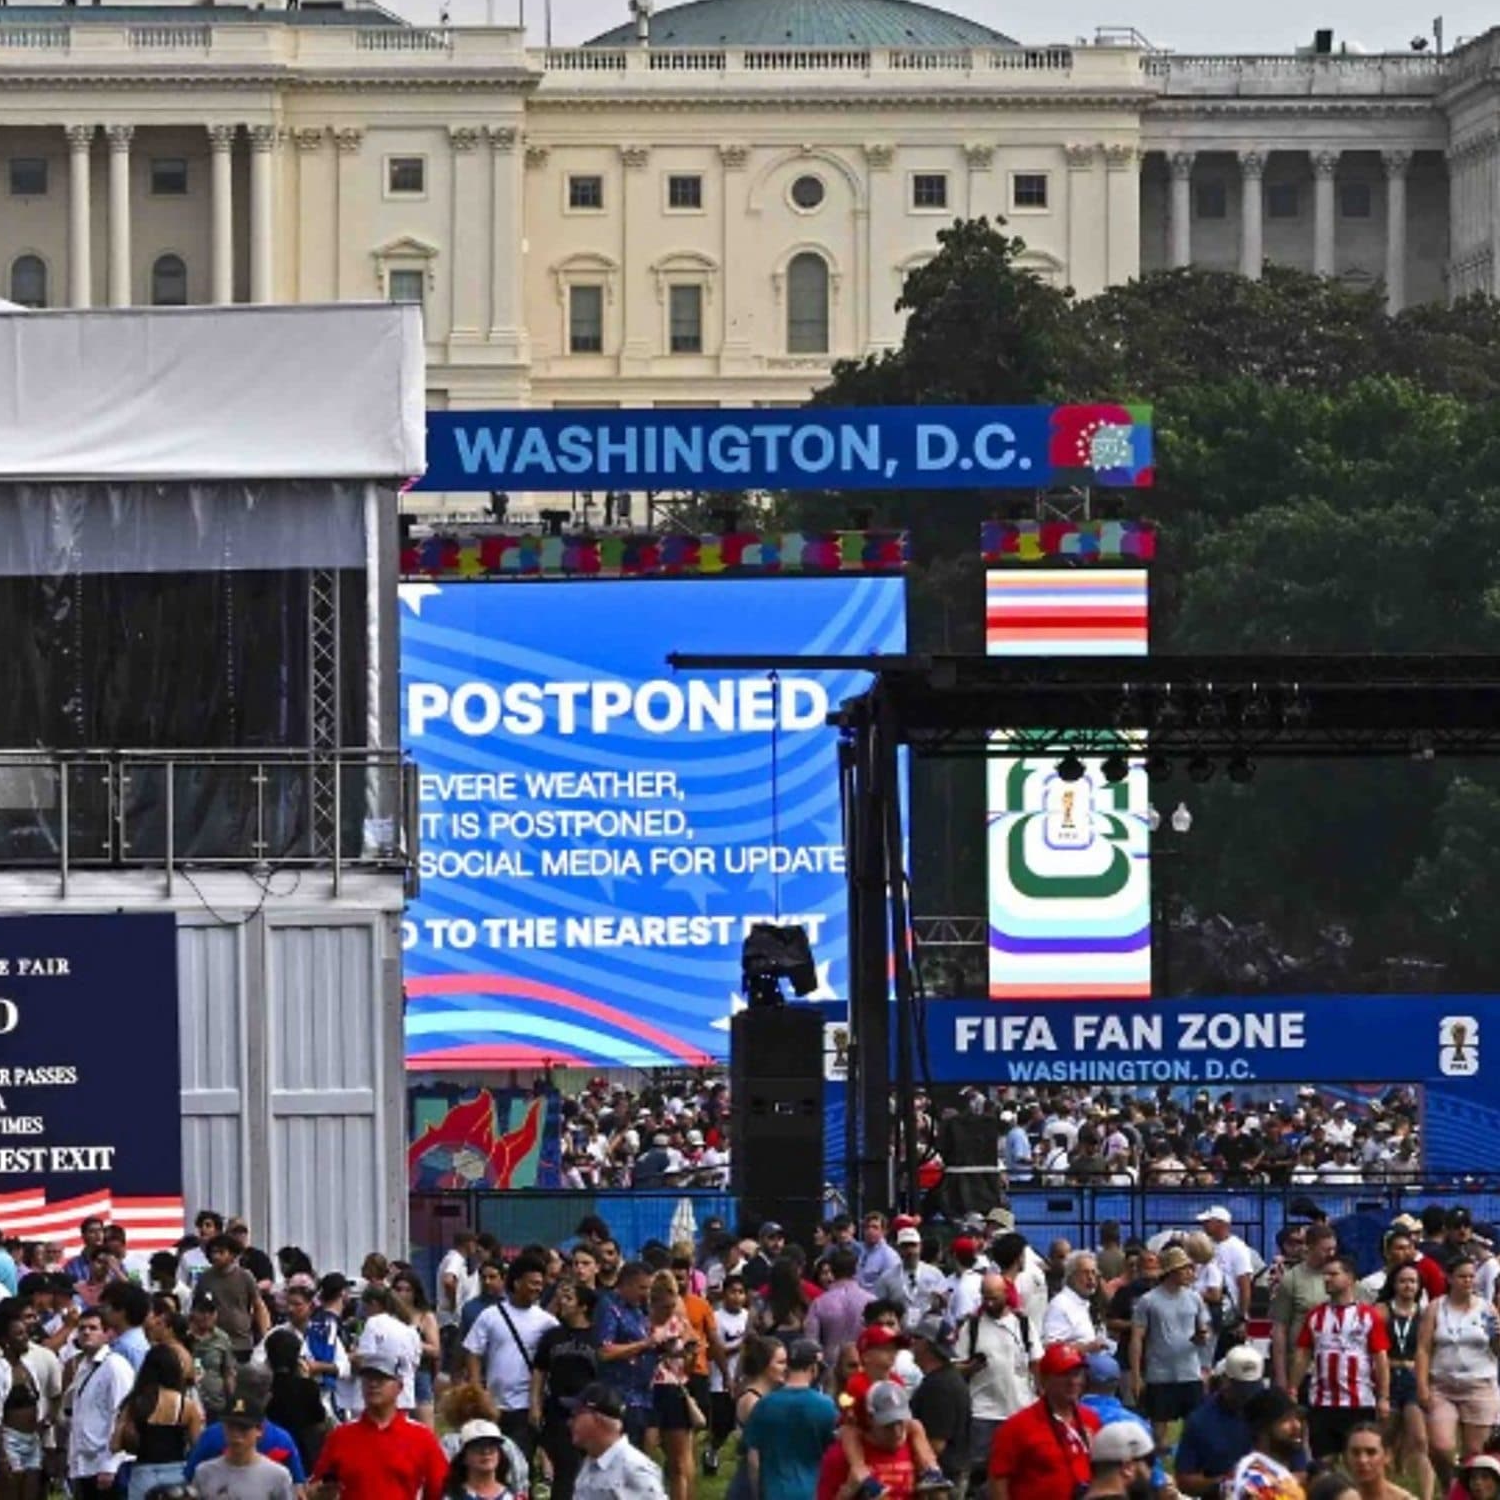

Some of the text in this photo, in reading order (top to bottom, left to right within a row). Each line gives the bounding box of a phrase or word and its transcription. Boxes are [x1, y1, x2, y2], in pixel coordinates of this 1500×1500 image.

[453, 424, 898, 478] WASHINGTON,
[916, 423, 1032, 470] D.C.
[407, 679, 829, 736] POSTPONED
[419, 771, 685, 801] EVERE WEATHER,
[452, 812, 480, 839] IS
[490, 809, 694, 840] POSTPONED,
[418, 846, 846, 879] SOCIAL MEDIA FOR UPDATE
[425, 918, 476, 949] TO
[482, 918, 556, 948] THE
[565, 915, 736, 948] NEAREST
[17, 958, 71, 976] FAIR
[955, 1012, 1307, 1051] FIFA FAN ZONE
[14, 1066, 78, 1085] PASSES
[1205, 1058, 1257, 1080] D.C.
[50, 1146, 115, 1172] EXIT
